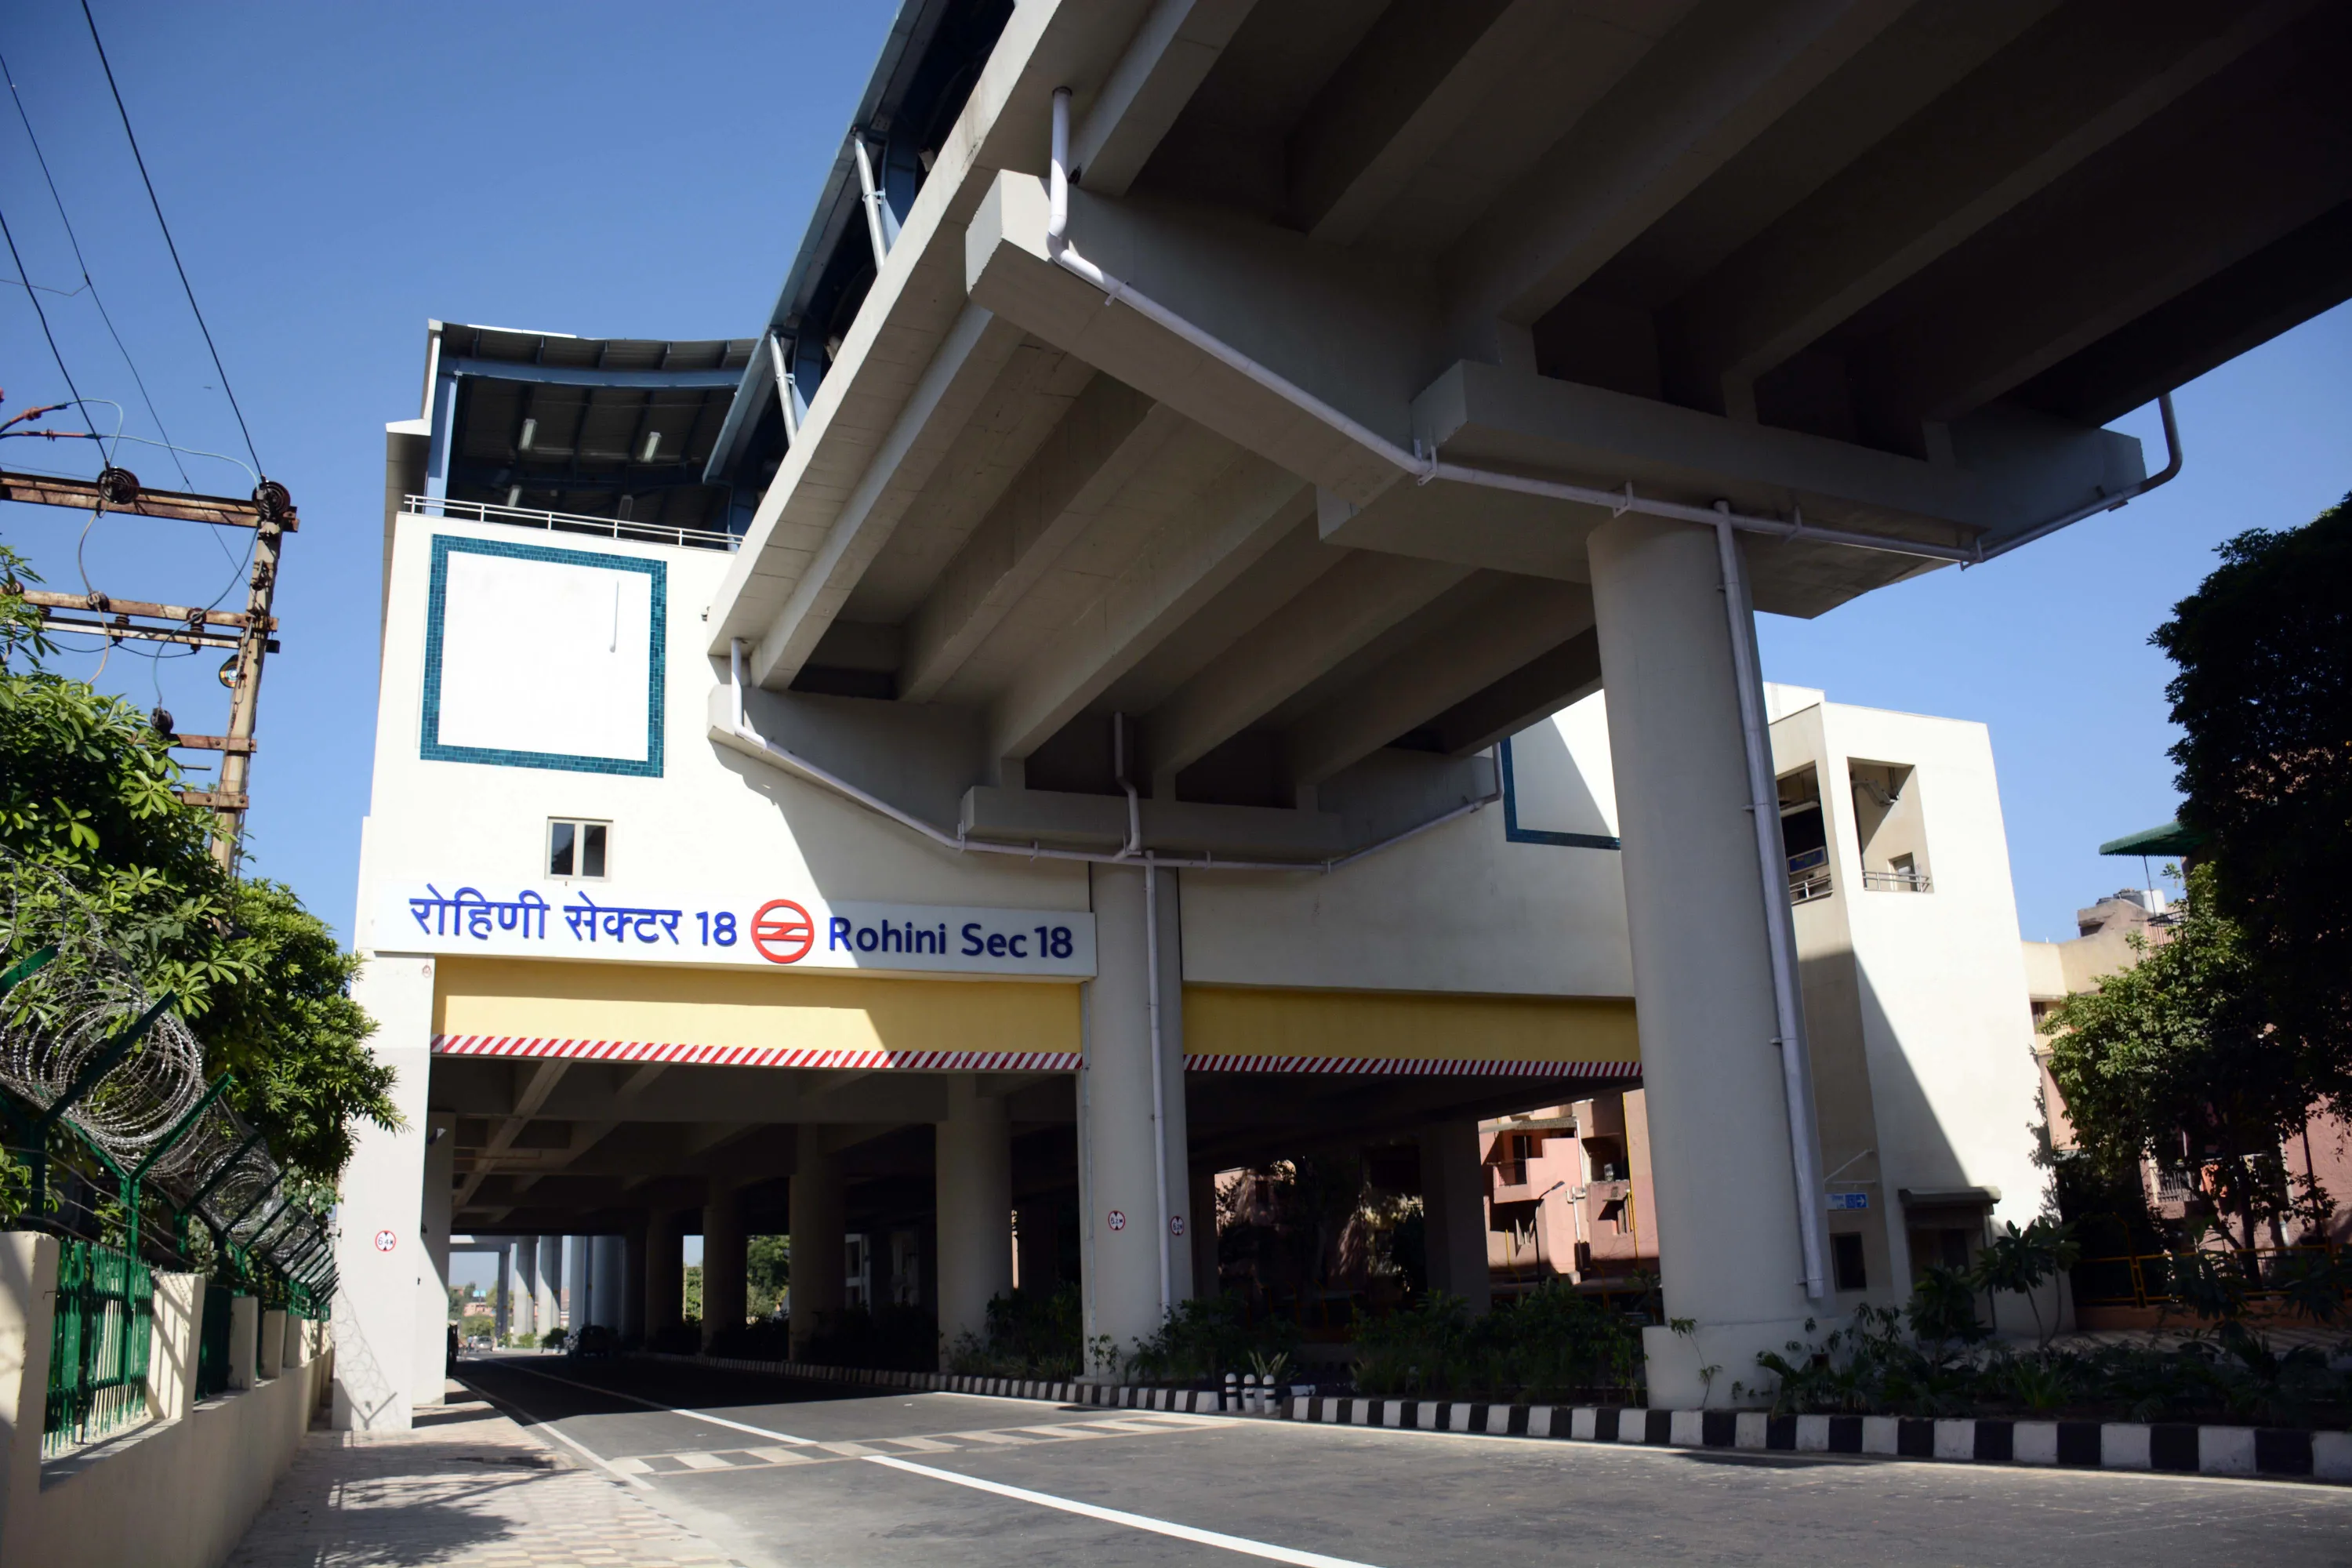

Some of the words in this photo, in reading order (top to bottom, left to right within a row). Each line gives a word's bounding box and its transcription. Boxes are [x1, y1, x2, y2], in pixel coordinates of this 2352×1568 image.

[409, 883, 550, 940] रोहिणी
[564, 891, 683, 945] सेक्टर
[696, 911, 738, 946] 18
[829, 916, 946, 955] Rohini
[961, 923, 1028, 958] Sec
[1035, 926, 1074, 959] 18
